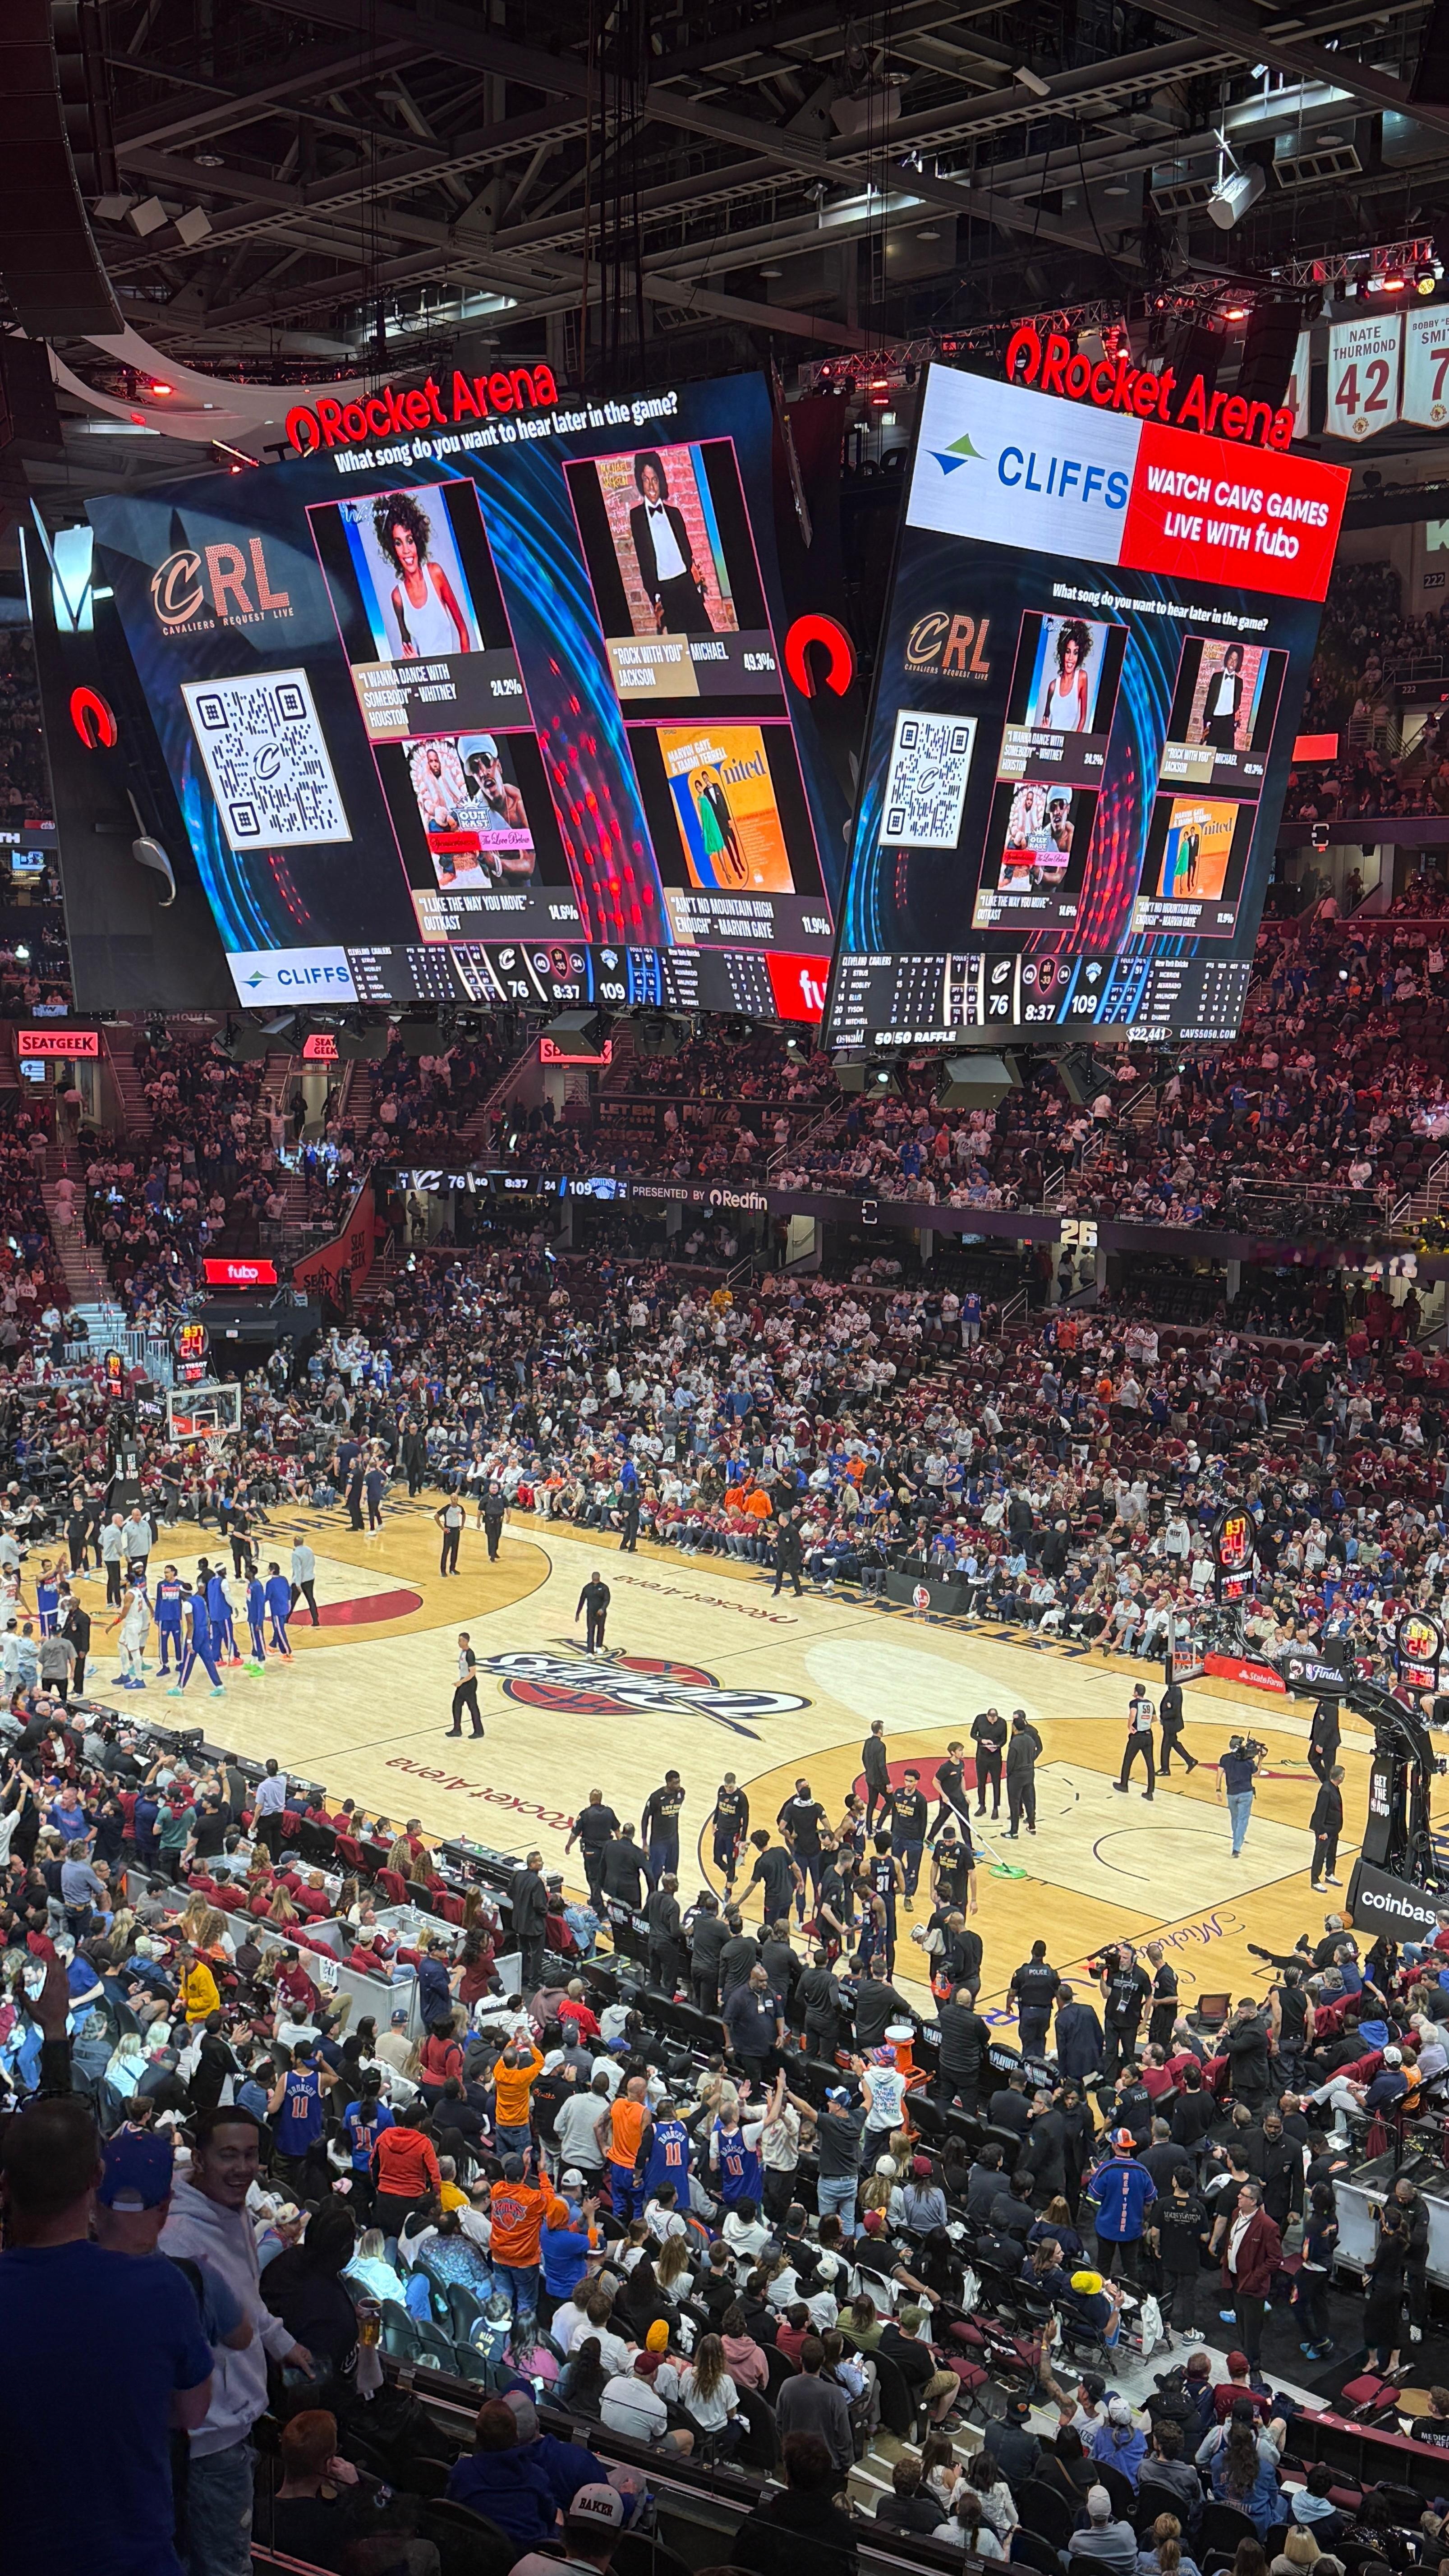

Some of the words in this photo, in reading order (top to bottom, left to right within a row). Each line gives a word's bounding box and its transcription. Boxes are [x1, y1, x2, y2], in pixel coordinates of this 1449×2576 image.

[1349, 326, 1381, 343] NATE
[1412, 319, 1439, 331] BOBBY
[1421, 329, 1449, 345] SMI
[1333, 339, 1396, 360] THURMOND
[1041, 333, 1176, 422] Rocket
[1177, 374, 1294, 450] Arena
[1335, 359, 1389, 415] 42
[316, 377, 447, 447] Rocket
[453, 365, 559, 422] Arena
[334, 449, 375, 473] What
[375, 443, 413, 467] song
[412, 437, 431, 459] do
[432, 435, 460, 460] you
[460, 425, 500, 450] want
[498, 422, 516, 443] to
[516, 418, 551, 440] hear
[552, 412, 587, 433] later
[587, 403, 604, 428] in
[604, 401, 630, 424] the
[632, 391, 677, 426] game?
[998, 446, 1128, 509] CLIFFS
[1148, 465, 1211, 502] WATCH
[1215, 481, 1263, 514] CAVS
[1266, 493, 1329, 527] GAMES
[1164, 511, 1203, 541] LIVE
[1207, 520, 1251, 551] WITH
[1255, 523, 1299, 559] fubo
[151, 538, 290, 625] CRL
[1425, 575, 1444, 586] 222
[1053, 583, 1078, 599] What
[1078, 589, 1100, 607] song
[1101, 591, 1113, 606] do
[1114, 595, 1132, 610] you
[1133, 598, 1157, 613] want
[1156, 601, 1167, 615] to
[1167, 603, 1190, 617] hear
[1189, 606, 1212, 622] later
[1212, 608, 1222, 623] in
[1222, 610, 1239, 626] the
[1238, 616, 1269, 631] game?
[163, 620, 215, 636] CAVALIERS
[223, 612, 265, 626] REQUEST
[274, 607, 294, 618] LIVE
[907, 612, 990, 672] CRL
[641, 645, 663, 663] WITH
[663, 644, 682, 662] YOU"
[690, 641, 729, 661] MICHAEL
[744, 653, 775, 671] 49.3%
[904, 663, 938, 674] CAVALIERS
[943, 669, 971, 678] REQUEST
[367, 669, 399, 688] WANNA
[398, 666, 428, 685] DANCE
[426, 663, 450, 681] WITH
[618, 668, 656, 686] JACKSON
[364, 689, 412, 708] SOMEBODY"
[419, 683, 457, 702] WHITNEY
[491, 679, 522, 696] 24.2%
[1402, 685, 1416, 694] 222
[368, 708, 409, 727] HOUSTON
[667, 744, 695, 763] MARVIN
[694, 738, 712, 753] GAYE
[676, 756, 700, 773] TAMMI
[699, 747, 728, 765] TERRELL
[459, 811, 487, 820] OUT
[460, 819, 489, 829] KAST
[480, 835, 491, 844] The
[491, 832, 507, 844] Love
[508, 832, 529, 843] Below
[428, 897, 448, 912] LIKE
[446, 897, 465, 911] THE
[463, 896, 483, 911] WAY
[482, 896, 501, 911] YOU
[501, 895, 527, 911] MOVE"
[549, 904, 579, 920] 14.6%
[698, 898, 710, 915] NO
[710, 898, 753, 916] MOUNTAIN
[752, 902, 774, 918] HIGH
[423, 915, 461, 931] OUTKAST
[675, 916, 711, 934] ENOUGH"
[718, 919, 753, 937] MARVIN
[753, 922, 774, 939] GAYE
[801, 916, 831, 934] 11.9%
[573, 959, 582, 967] 24
[277, 966, 350, 985] CLIFFS
[507, 980, 529, 998] 76
[552, 984, 580, 999] 8:37
[600, 983, 626, 999] 109
[989, 995, 1009, 1015] 76
[1072, 995, 1097, 1013] 109
[1025, 1004, 1056, 1021] 8:37
[22, 1036, 94, 1051] SEATGEEK
[836, 1030, 864, 1044] oswald
[874, 1031, 911, 1045] 50/50
[914, 1031, 957, 1043] RAFFLE
[1128, 1028, 1166, 1043] $22,441
[1180, 1029, 1237, 1039] CAVS5050.COM
[600, 1103, 630, 1115] LET
[632, 1105, 655, 1116] EM
[448, 1176, 465, 1189] 76
[475, 1178, 488, 1187] 40
[505, 1178, 528, 1188] 8:37
[544, 1181, 556, 1190] 24
[569, 1182, 592, 1196] 109
[633, 1186, 688, 1199] PRESENTED
[693, 1191, 705, 1201] BY
[723, 1190, 767, 1210] Redfin
[619, 1190, 626, 1198] 2
[1060, 1219, 1098, 1247] 26
[228, 1265, 258, 1279] fubo
[181, 1336, 202, 1357] 24
[1220, 1533, 1244, 1564] 24
[613, 1575, 690, 1596] Arena
[1231, 1571, 1252, 1583] TISSOT
[682, 1594, 777, 1618] Rocket
[1409, 1638, 1428, 1656] 24
[1310, 1665, 1343, 1681] Finals
[1410, 1663, 1435, 1673] TISSOT
[385, 1757, 482, 1789] Arena
[1374, 1774, 1387, 1788] GET
[1374, 1786, 1387, 1801] THE
[467, 1788, 574, 1831] Rocket
[1376, 1801, 1389, 1817] App
[877, 1875, 889, 1892] 31
[1362, 1891, 1436, 1925] coinbas
[287, 2084, 316, 2097] BRUNSON
[292, 2096, 308, 2118] 11
[658, 2130, 685, 2144] BRUNSON
[666, 2142, 681, 2166] 11
[726, 2155, 744, 2175] 11
[578, 2498, 613, 2517] BAKER
